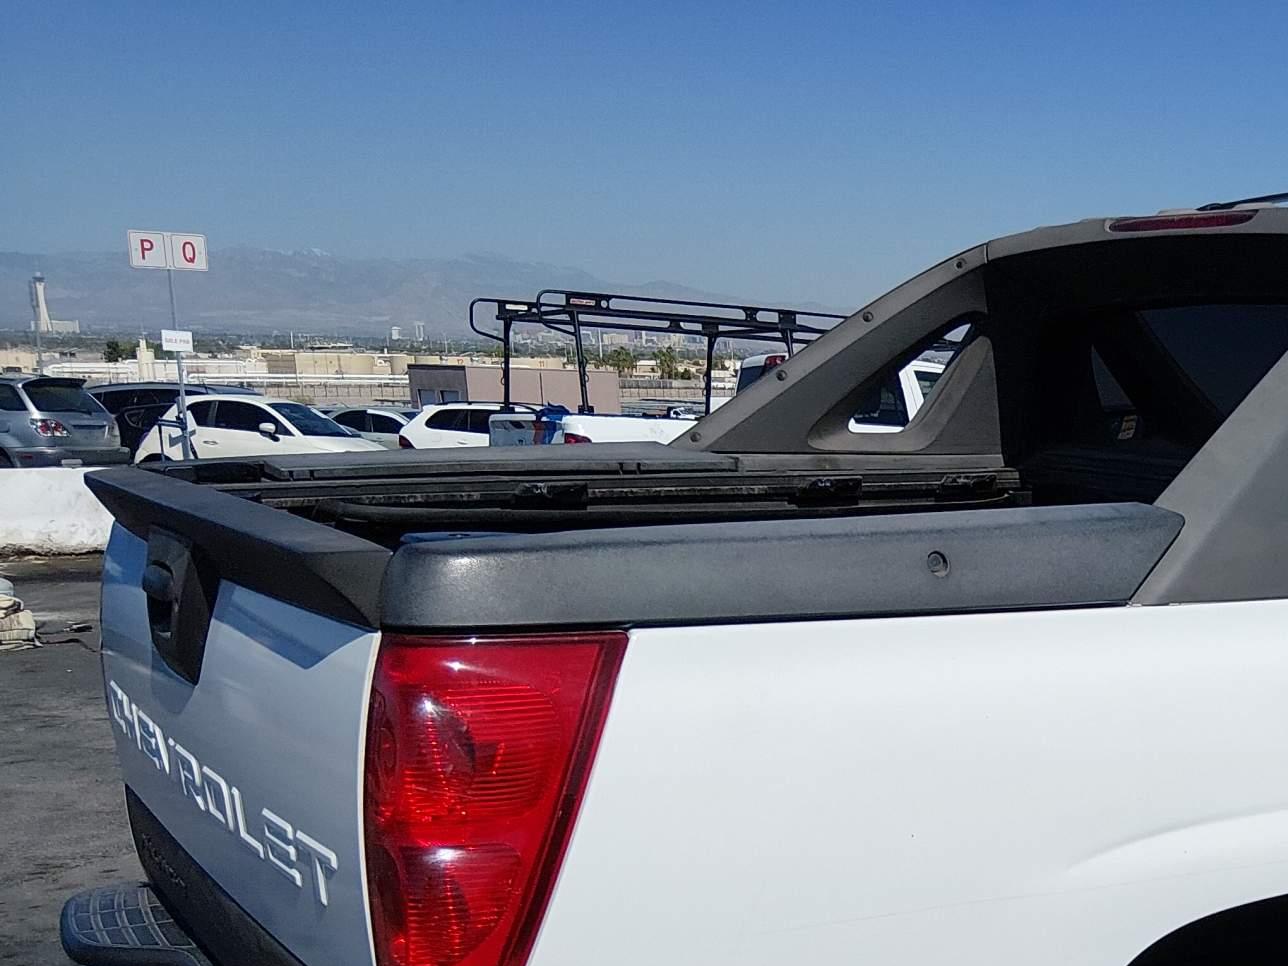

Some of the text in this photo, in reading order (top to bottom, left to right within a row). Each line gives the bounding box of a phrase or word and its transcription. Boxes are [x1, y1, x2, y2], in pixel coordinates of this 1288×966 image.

[140, 239, 197, 264] P Q
[109, 679, 338, 907] CHEVROLET
